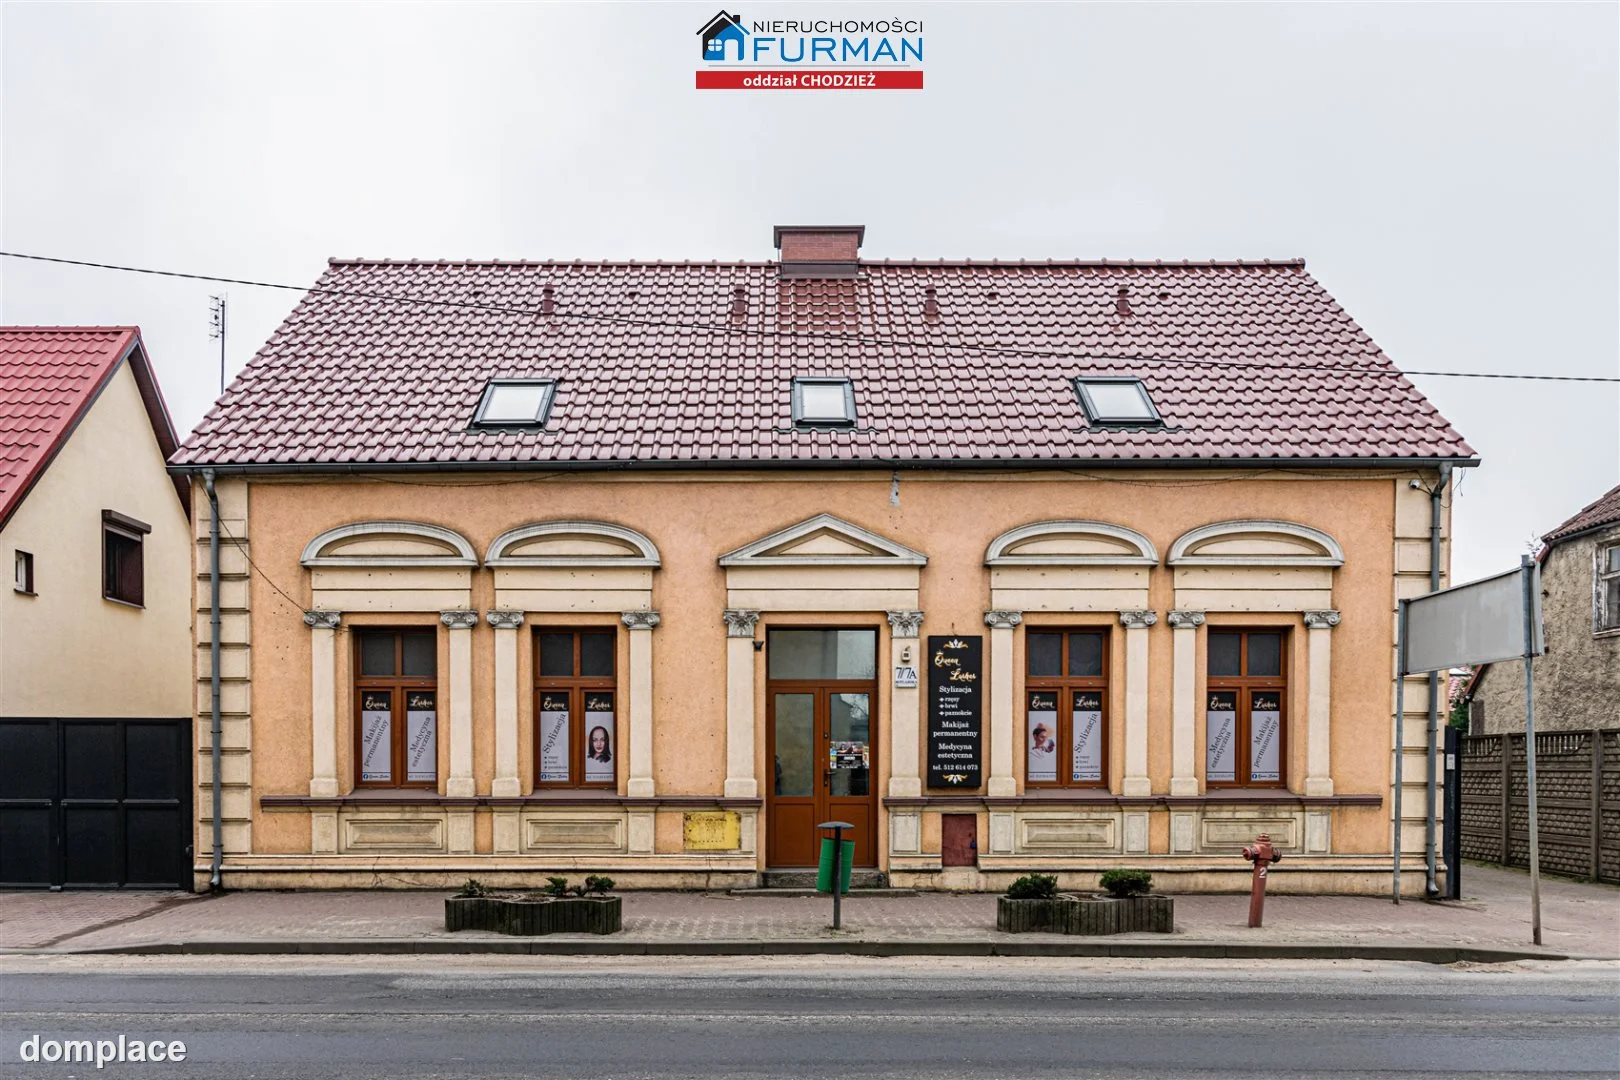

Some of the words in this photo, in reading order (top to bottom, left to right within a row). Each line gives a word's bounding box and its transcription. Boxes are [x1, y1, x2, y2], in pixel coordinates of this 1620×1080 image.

[939, 685, 972, 694] Stylizacja
[410, 717, 431, 752] Medycyna
[543, 713, 566, 754] Stylizacja
[941, 721, 969, 729] Makijaż
[1074, 713, 1098, 753] Stylizacja
[1209, 718, 1231, 753] Medycyna
[364, 720, 389, 767] permanentny
[412, 730, 432, 767] estetyczna
[938, 743, 972, 751] Medycyna
[1211, 731, 1231, 768] estetyczna
[1253, 720, 1279, 768] permanentny
[1259, 867, 1267, 877] 2
